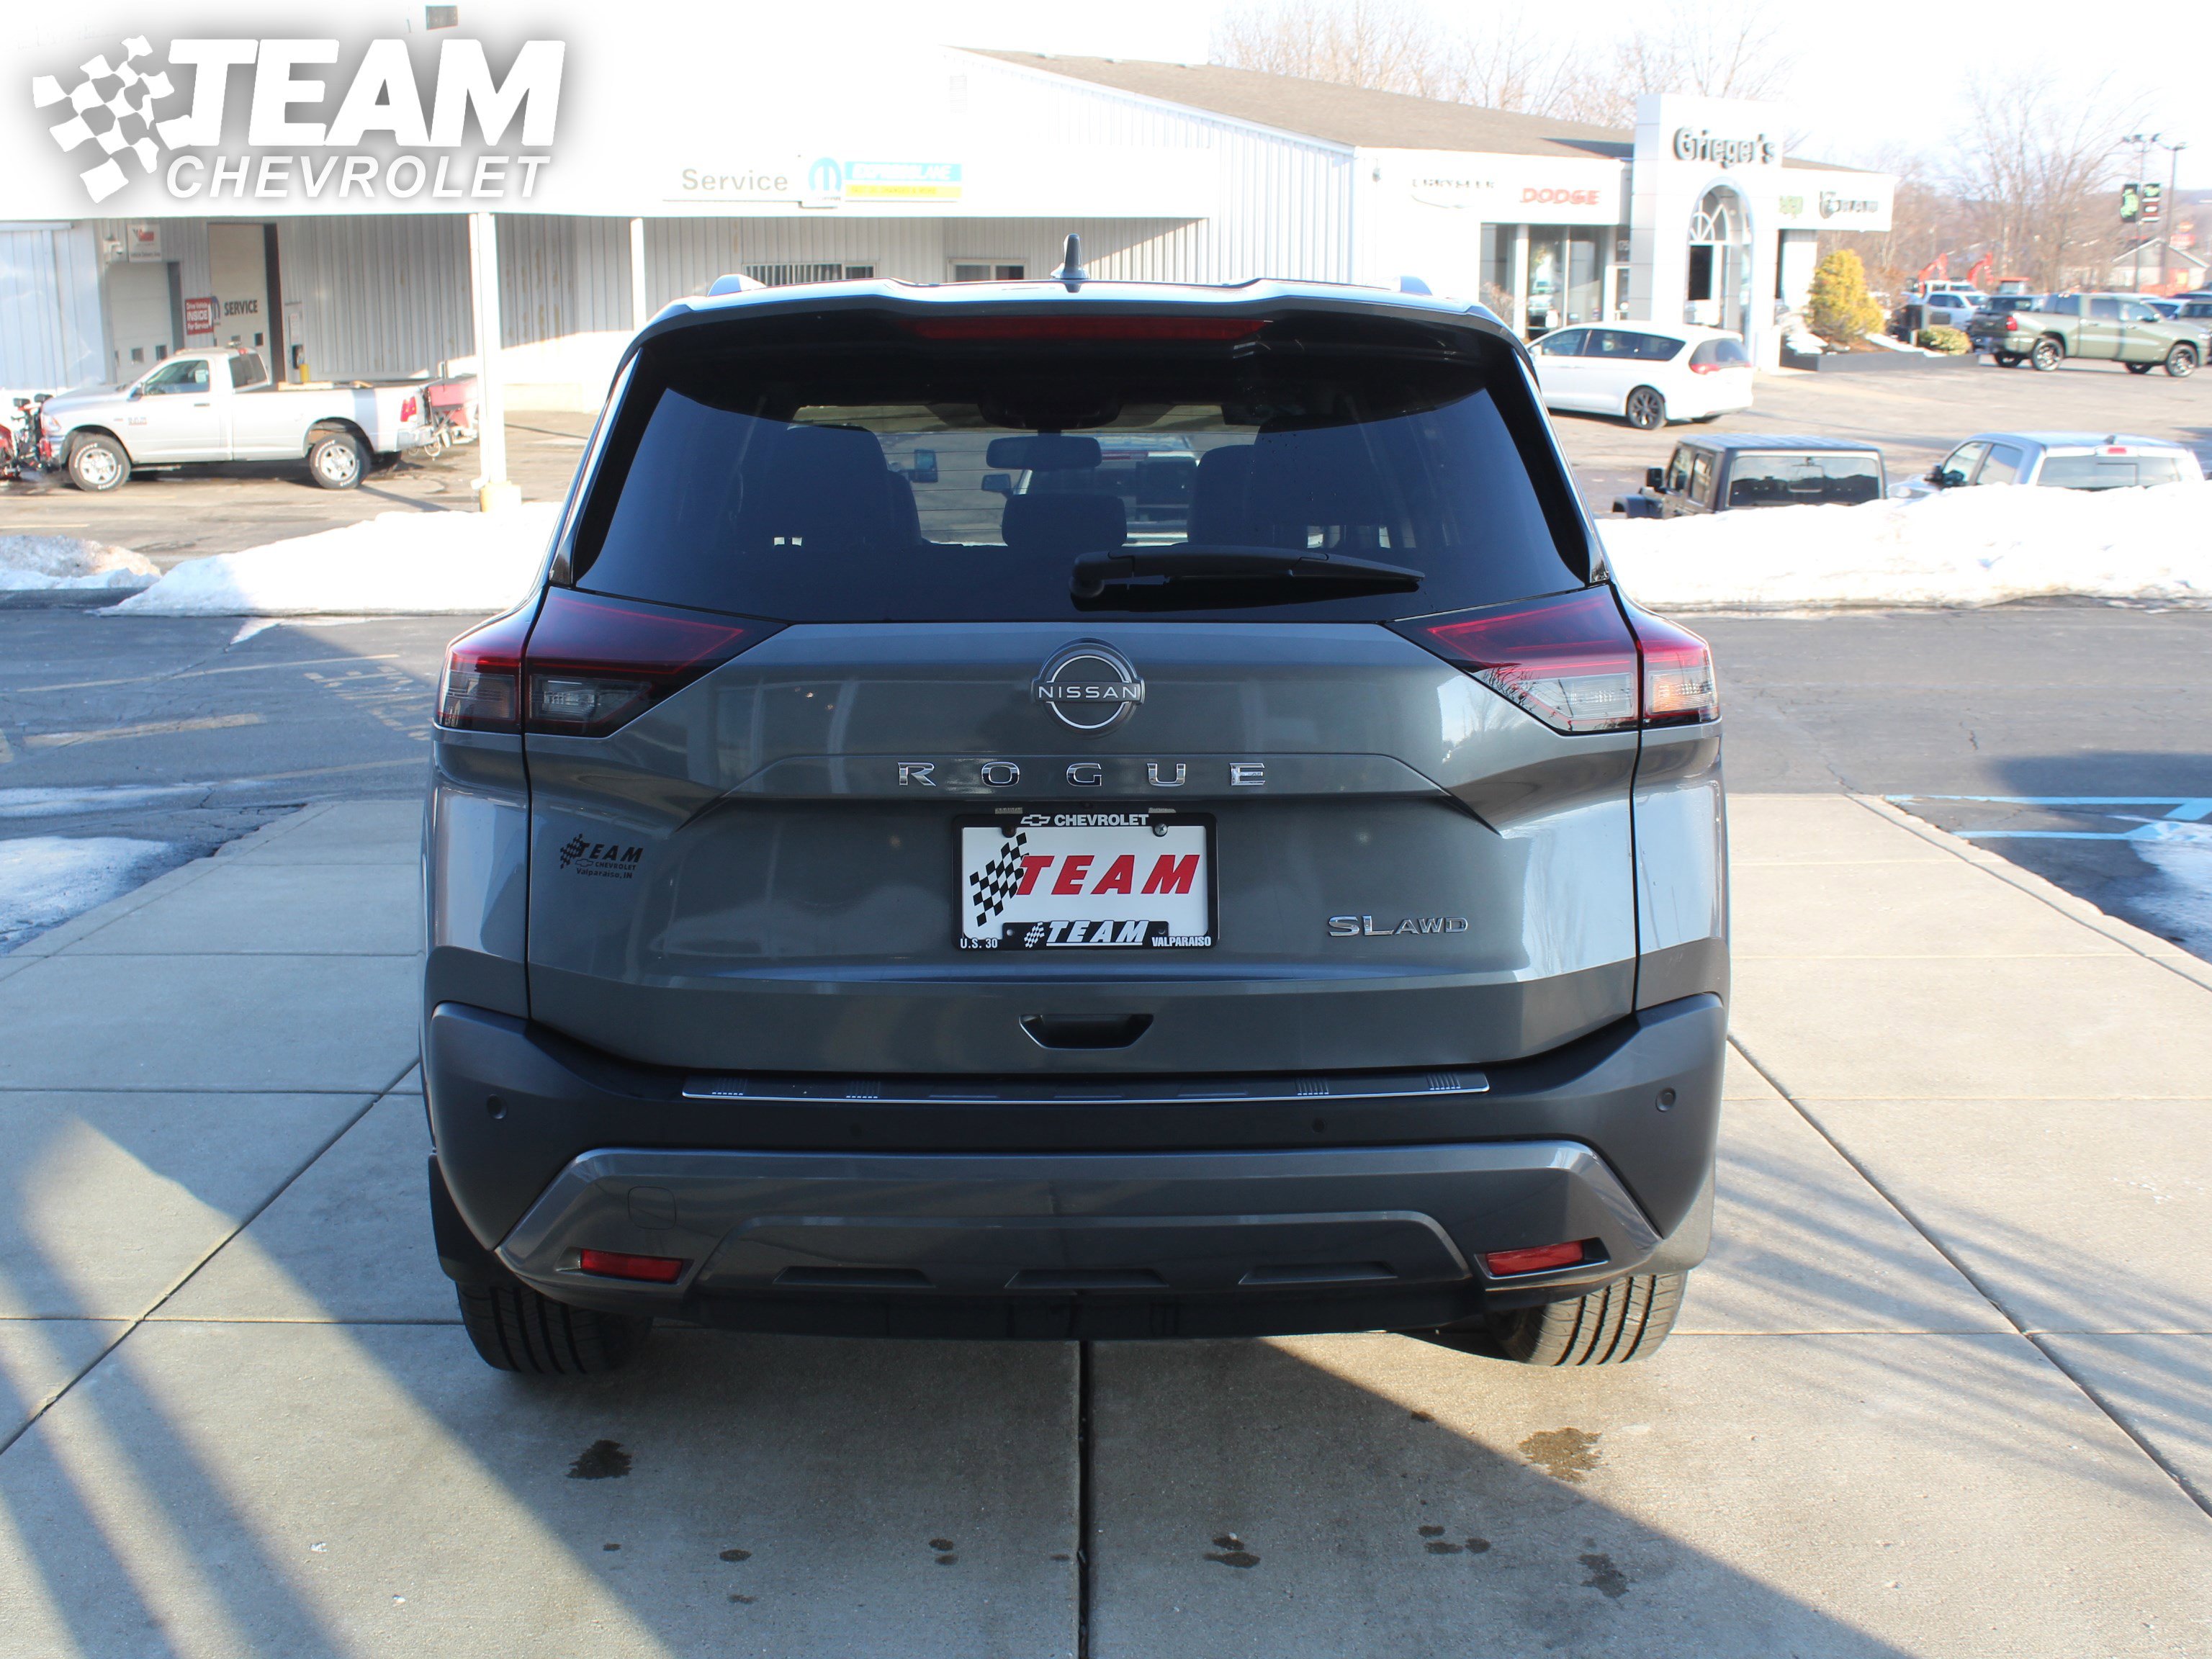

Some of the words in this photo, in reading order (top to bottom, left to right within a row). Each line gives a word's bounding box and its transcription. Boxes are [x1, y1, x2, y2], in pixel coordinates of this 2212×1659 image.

[1673, 126, 1775, 169] Grieger's
[682, 168, 788, 192] Service
[1519, 187, 1601, 205] DODGE
[186, 310, 208, 322] INSIDE
[224, 300, 258, 316] SERVICE
[1038, 685, 1139, 699] NISSAN
[897, 761, 1267, 788] ROGUE
[1054, 814, 1149, 826] CHEVROLET
[576, 842, 644, 863] TEAM
[576, 868, 622, 878] Valparaiso,
[595, 861, 637, 871] CHEVROLET
[1016, 855, 1200, 895] TEAM
[1048, 920, 1150, 943] TEAM
[960, 938, 982, 949] U.S.
[984, 938, 998, 949] 30
[1151, 937, 1212, 948] VALPARAISO
